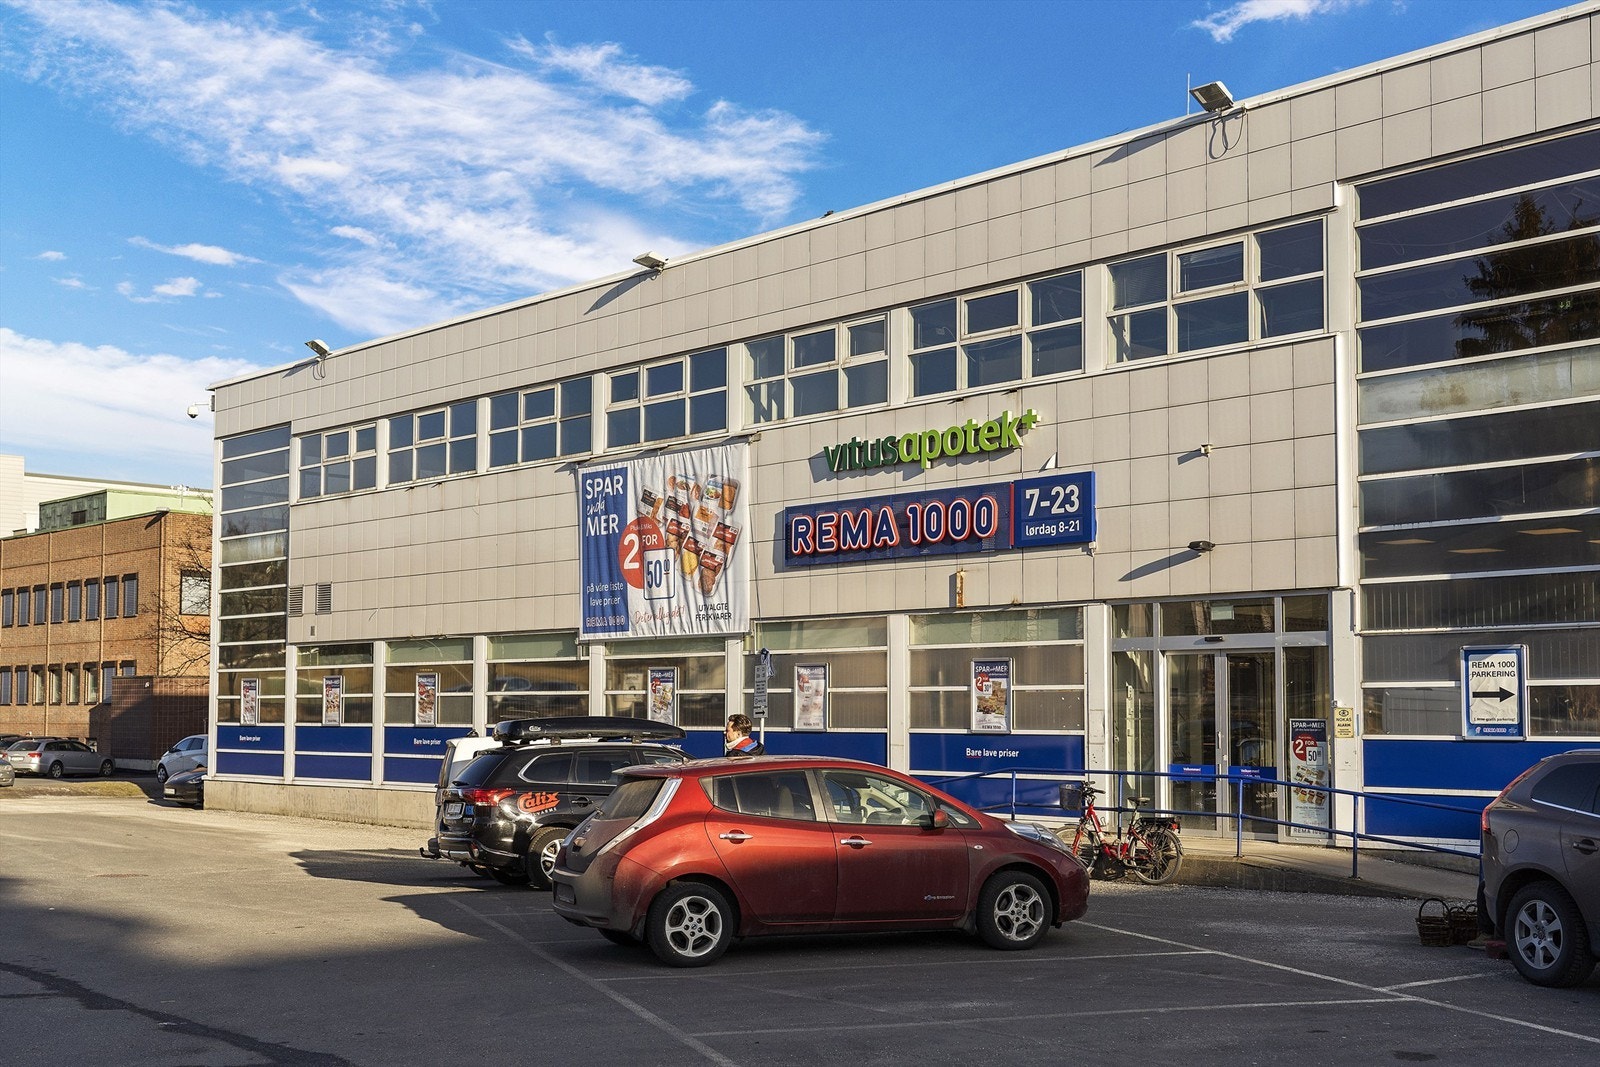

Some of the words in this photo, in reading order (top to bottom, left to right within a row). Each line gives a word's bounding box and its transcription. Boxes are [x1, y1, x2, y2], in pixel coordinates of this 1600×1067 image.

[585, 475, 624, 500] SPAR
[1025, 484, 1081, 517] 7-23
[586, 514, 619, 537] MER
[791, 505, 900, 555] REMA
[906, 494, 999, 546] 1000
[1025, 522, 1057, 537] lørdag
[1058, 520, 1081, 533] 8-21
[623, 533, 640, 571] 2
[586, 582, 595, 594] på
[1471, 661, 1495, 669] REMA
[966, 747, 982, 757] Bare
[983, 748, 998, 757] lave
[998, 748, 1020, 758] priser
[1295, 739, 1304, 754] 2
[517, 791, 560, 813] Calix
